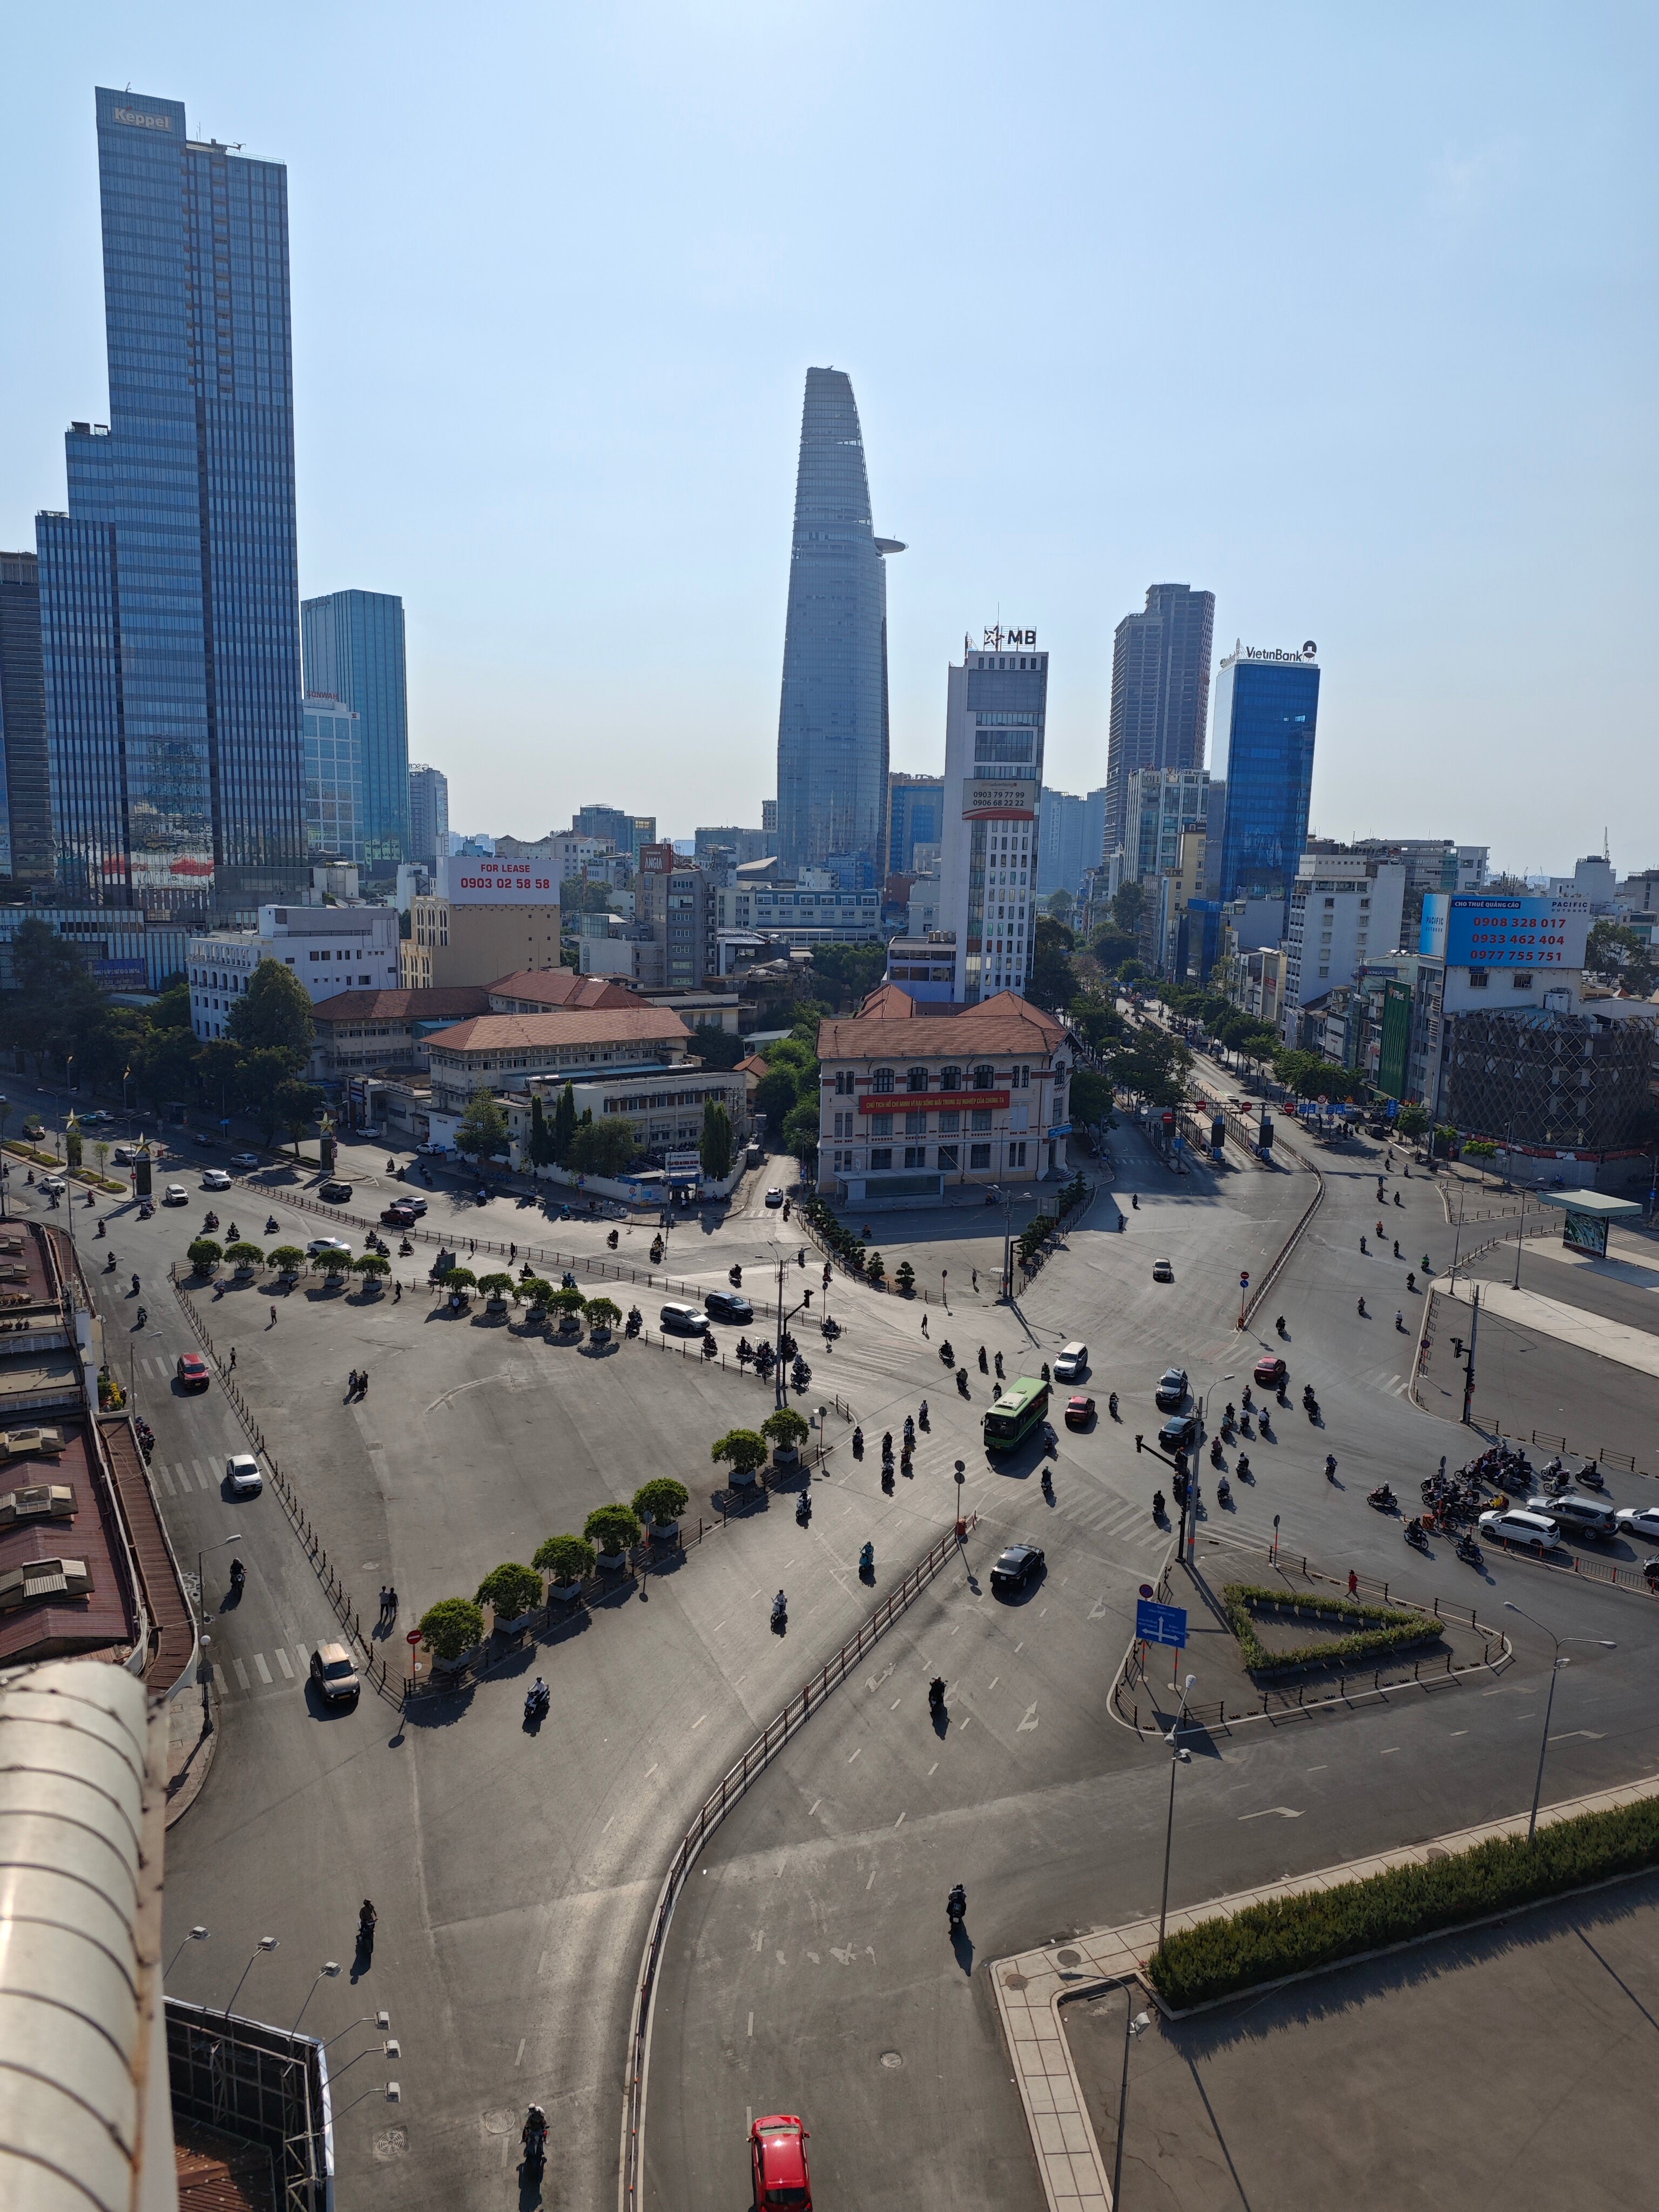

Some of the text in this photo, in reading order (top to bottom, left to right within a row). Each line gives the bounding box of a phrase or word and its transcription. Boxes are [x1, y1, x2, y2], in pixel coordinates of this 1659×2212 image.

[114, 107, 170, 128] Keppel
[1007, 630, 1036, 645] MB
[1246, 646, 1303, 662] VietinBank
[306, 691, 339, 701] SUNWAH
[481, 864, 530, 873] FOR LEASE
[461, 878, 550, 889] 0903 02 58 58
[1426, 916, 1444, 926] PACIFIC
[1474, 917, 1566, 928] 0908 328 017
[1472, 934, 1564, 945] 0933 462 404
[1470, 950, 1562, 961] 0977 755 751
